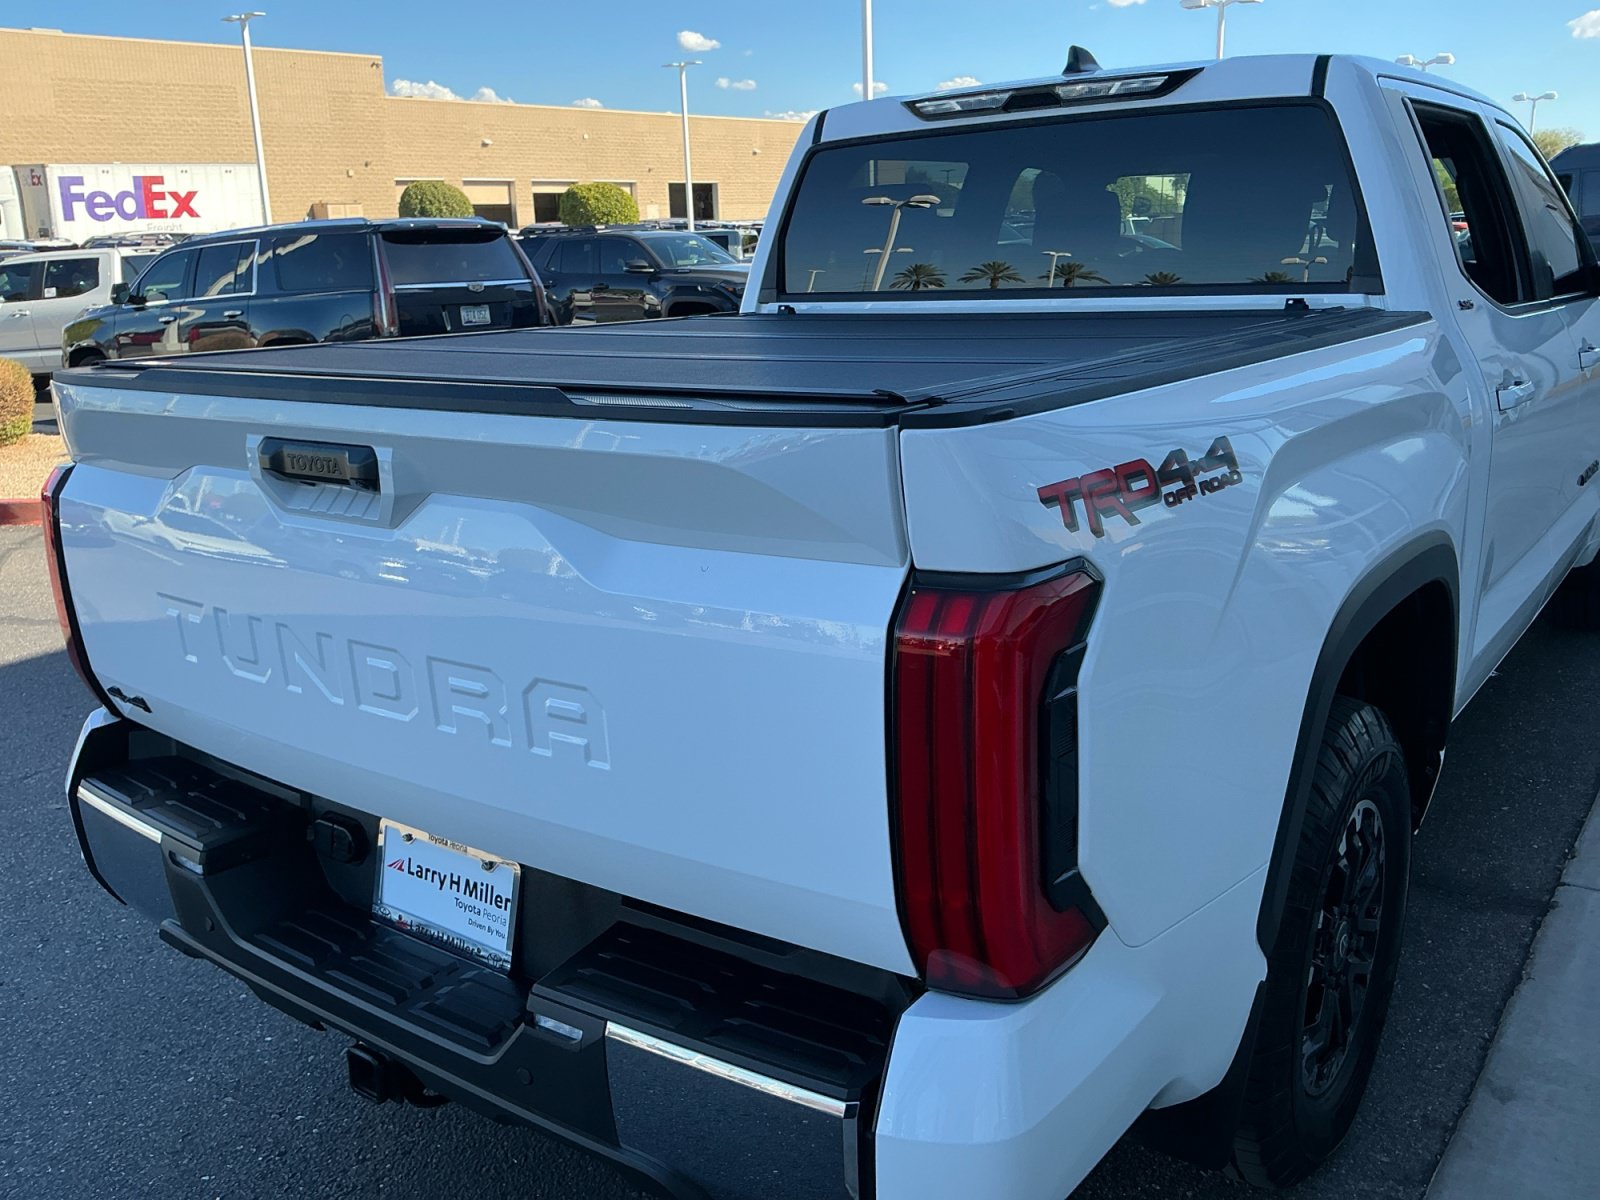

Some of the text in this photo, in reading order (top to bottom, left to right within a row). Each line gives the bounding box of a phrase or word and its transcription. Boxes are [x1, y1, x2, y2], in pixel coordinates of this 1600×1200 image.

[58, 175, 201, 222] FedEx
[287, 453, 342, 475] TOYOTA
[1037, 458, 1162, 539] TRD
[1163, 469, 1243, 508] OFF ROAD
[156, 592, 611, 770] TUNDRA
[428, 832, 449, 847] Toyota
[407, 857, 512, 912] Larry H Miller
[454, 897, 508, 927] Toyota Peoria
[467, 917, 506, 939] Driven By You
[409, 919, 436, 939] Larry
[446, 936, 476, 954] Miller
